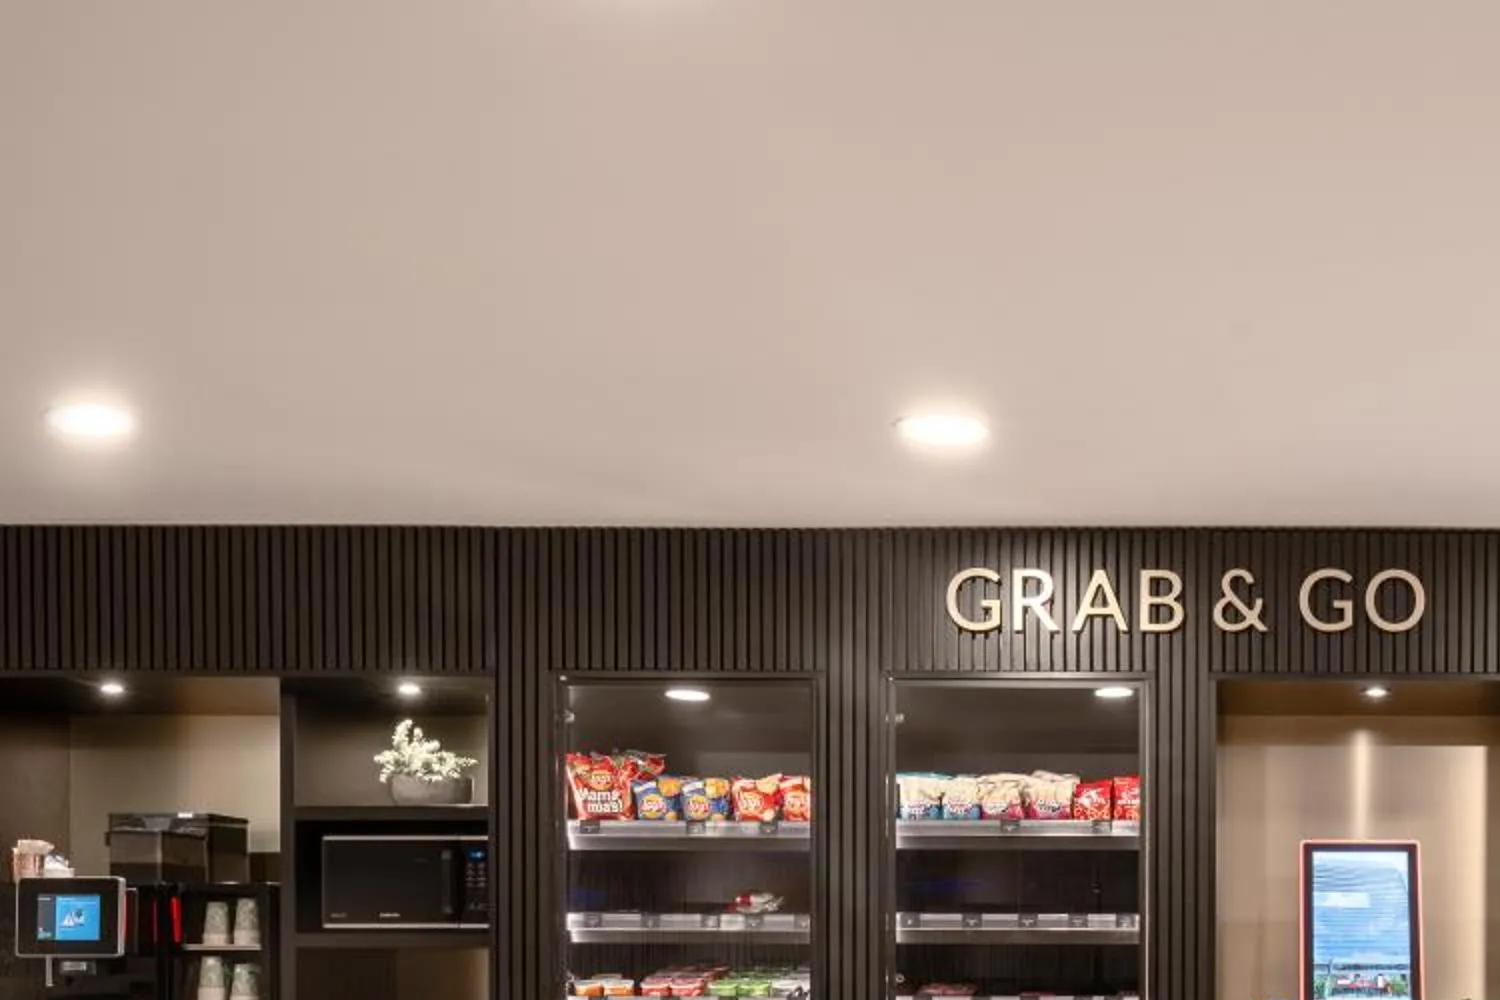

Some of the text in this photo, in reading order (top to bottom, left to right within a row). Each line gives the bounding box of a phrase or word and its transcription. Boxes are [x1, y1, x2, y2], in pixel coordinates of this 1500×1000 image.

[946, 567, 1427, 633] GRAB & GO
